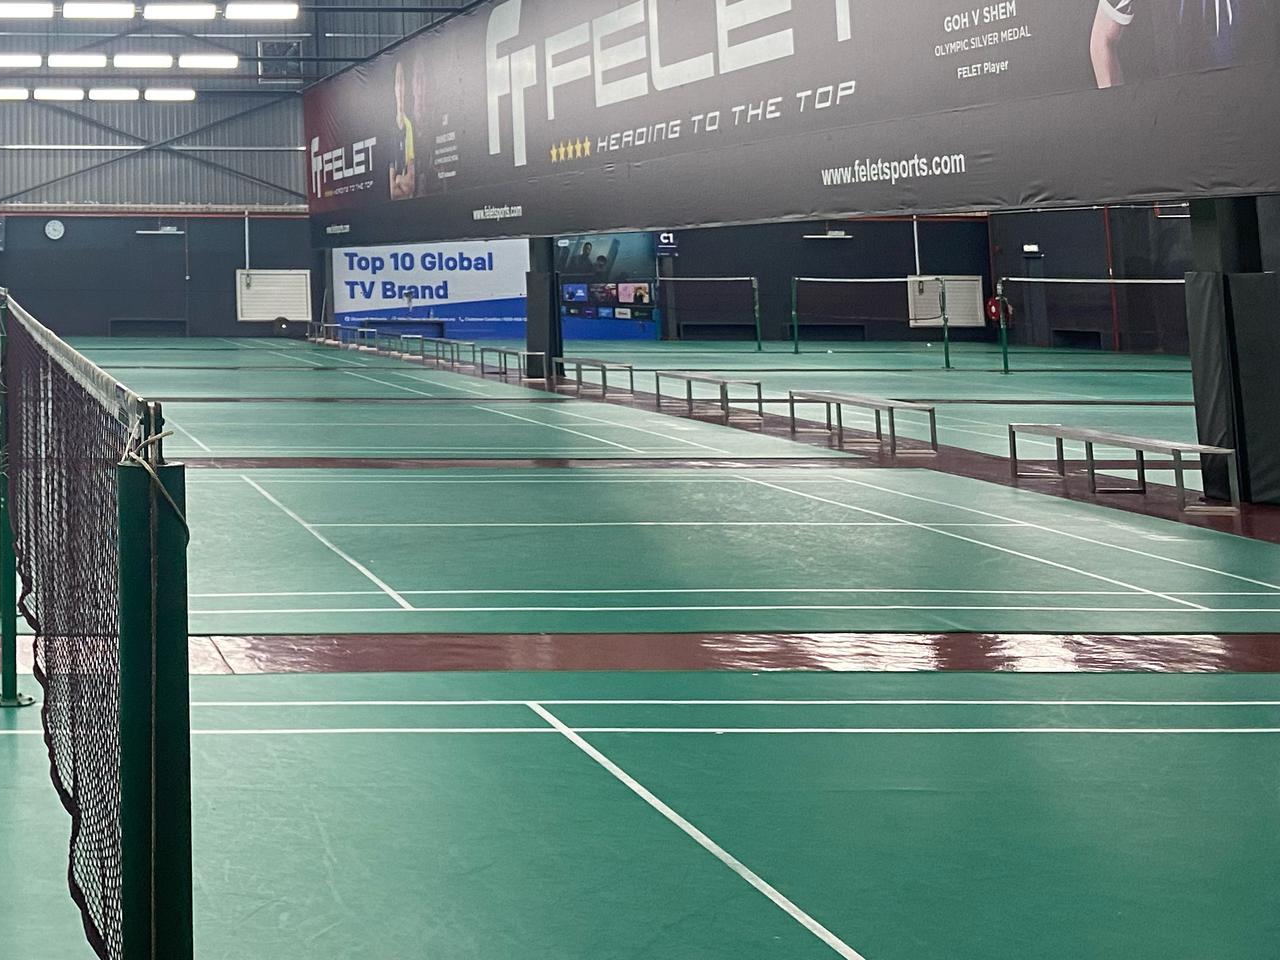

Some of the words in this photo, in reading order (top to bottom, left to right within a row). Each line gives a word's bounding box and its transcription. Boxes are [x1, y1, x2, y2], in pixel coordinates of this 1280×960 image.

[943, 12, 969, 32] GOH
[971, 9, 980, 26] V
[983, 0, 1017, 23] SHEM
[934, 39, 969, 57] OLYMPIC
[970, 32, 999, 49] SILVER
[1000, 25, 1032, 43] MEDAL
[957, 64, 982, 79] FELET
[983, 60, 1009, 74] Player
[596, 119, 683, 153] HEADING
[691, 110, 720, 133] TO
[731, 96, 784, 126] THE
[796, 80, 856, 112] TOP
[323, 136, 377, 184] FELET
[821, 153, 966, 186] www.feletsports.com
[659, 232, 674, 244] C1
[344, 252, 385, 275] Top
[389, 252, 415, 271] 10
[420, 252, 493, 271] Global
[344, 280, 376, 299] TV
[381, 280, 449, 299] Brand
